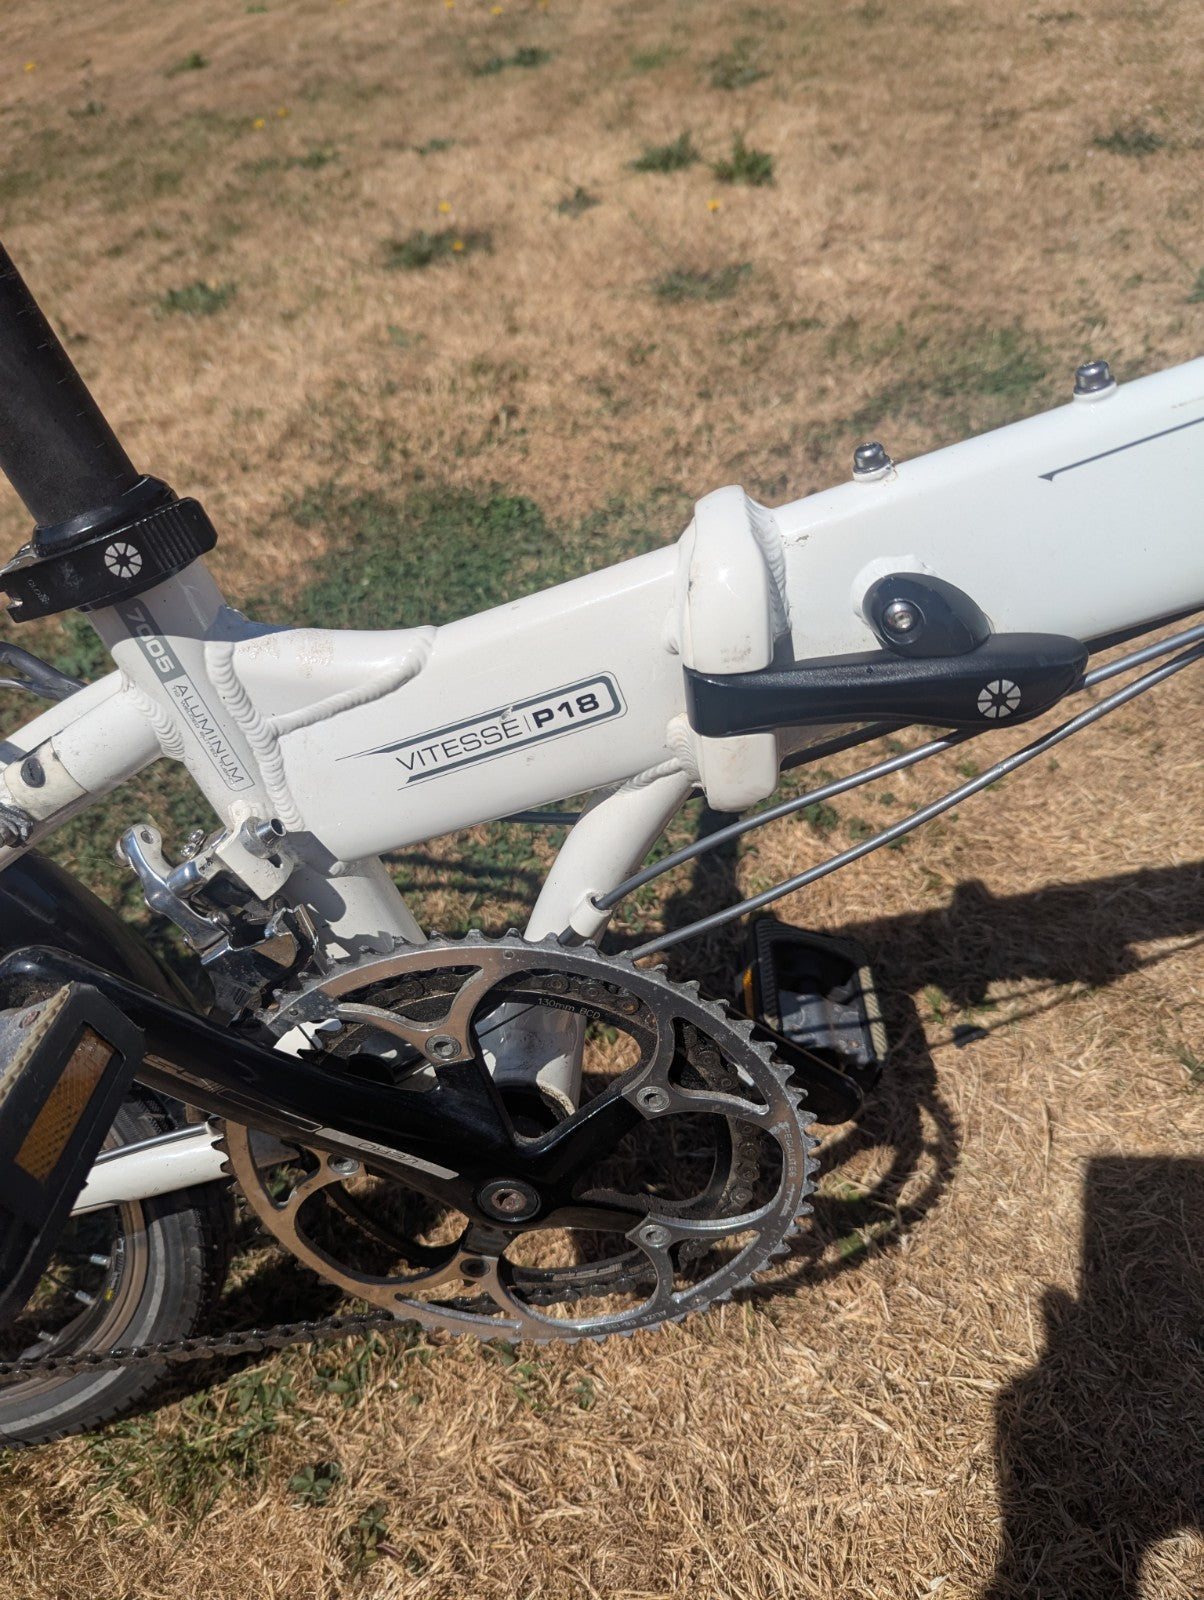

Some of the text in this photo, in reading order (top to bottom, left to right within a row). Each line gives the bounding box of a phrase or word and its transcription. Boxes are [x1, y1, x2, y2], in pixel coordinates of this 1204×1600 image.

[127, 606, 244, 783] 7005 ALUMINUM
[181, 700, 200, 729] WELDED
[396, 693, 600, 771] VITESSE P18
[538, 998, 600, 1019] 130mm BCD
